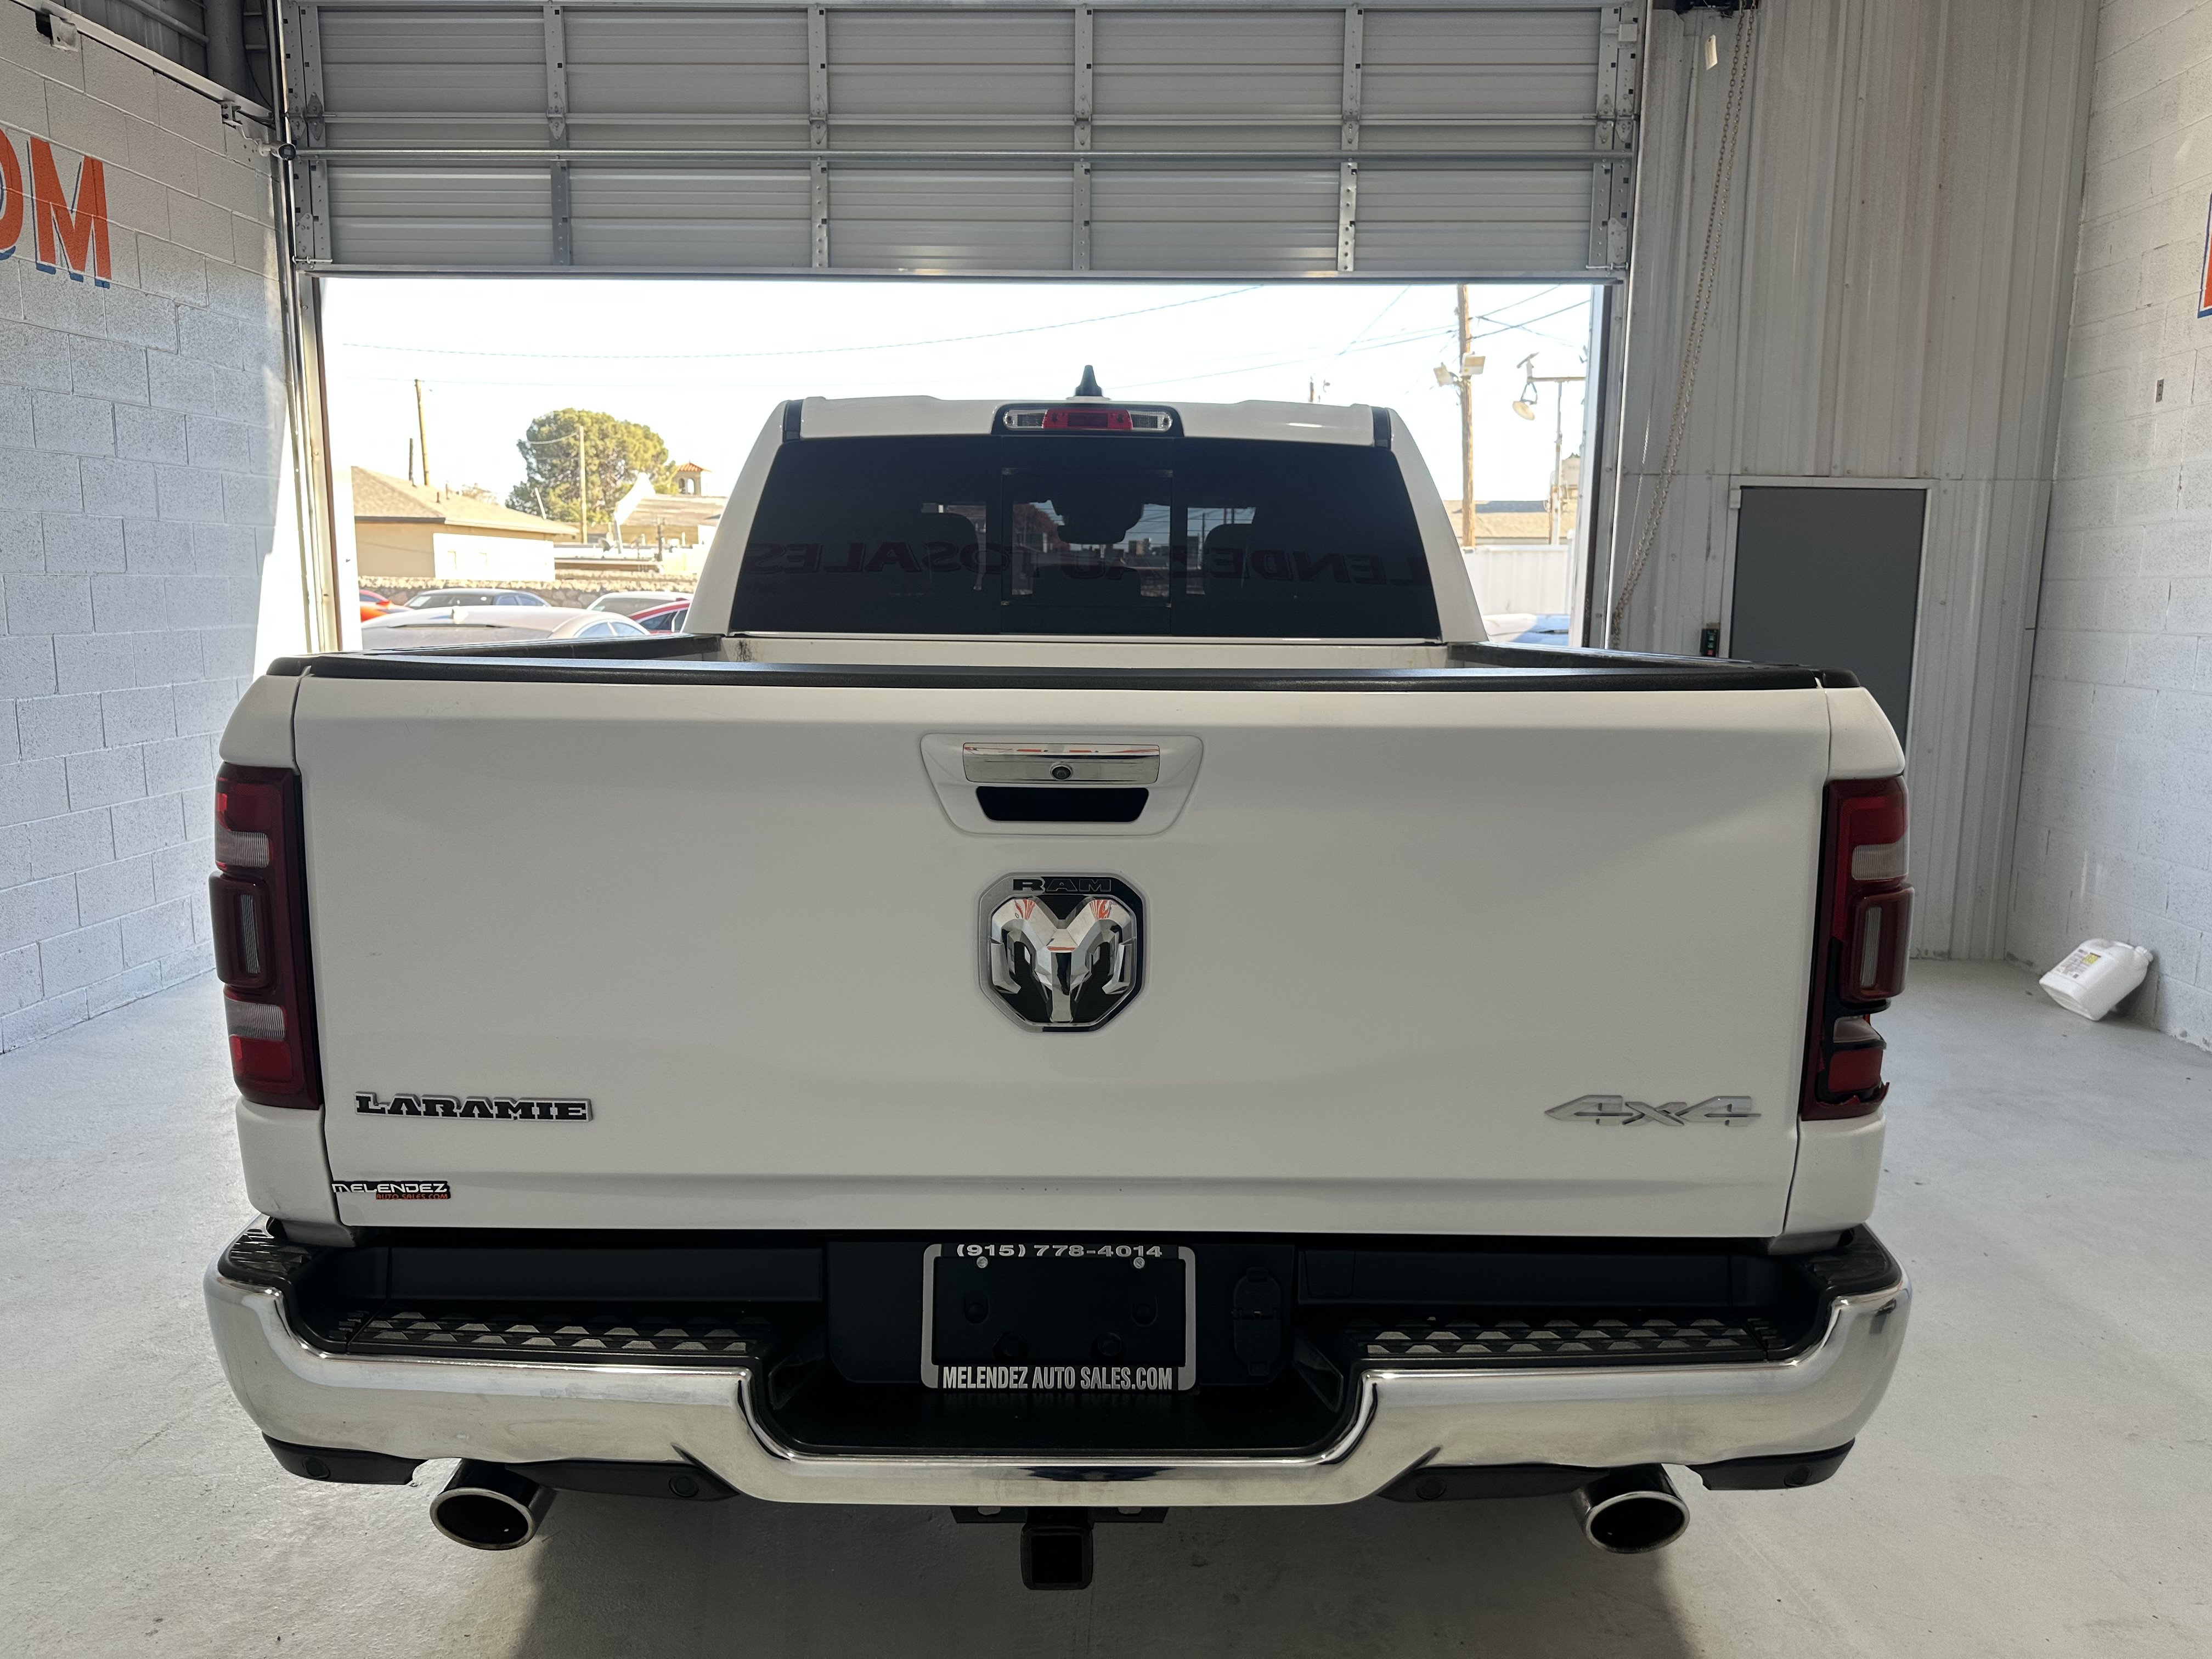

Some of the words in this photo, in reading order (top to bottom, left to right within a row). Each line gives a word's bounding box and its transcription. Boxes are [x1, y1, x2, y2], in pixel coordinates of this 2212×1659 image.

[1013, 879, 1111, 892] RAM
[356, 1092, 591, 1122] LARAMIE
[331, 1183, 447, 1193] MELENDEZ
[957, 1244, 1026, 1257] (915)
[1034, 1244, 1163, 1257] 778-4014
[943, 1366, 1028, 1389] MELENDEZ
[1032, 1366, 1076, 1390] AUTO
[1080, 1367, 1173, 1390] SALES.COM
